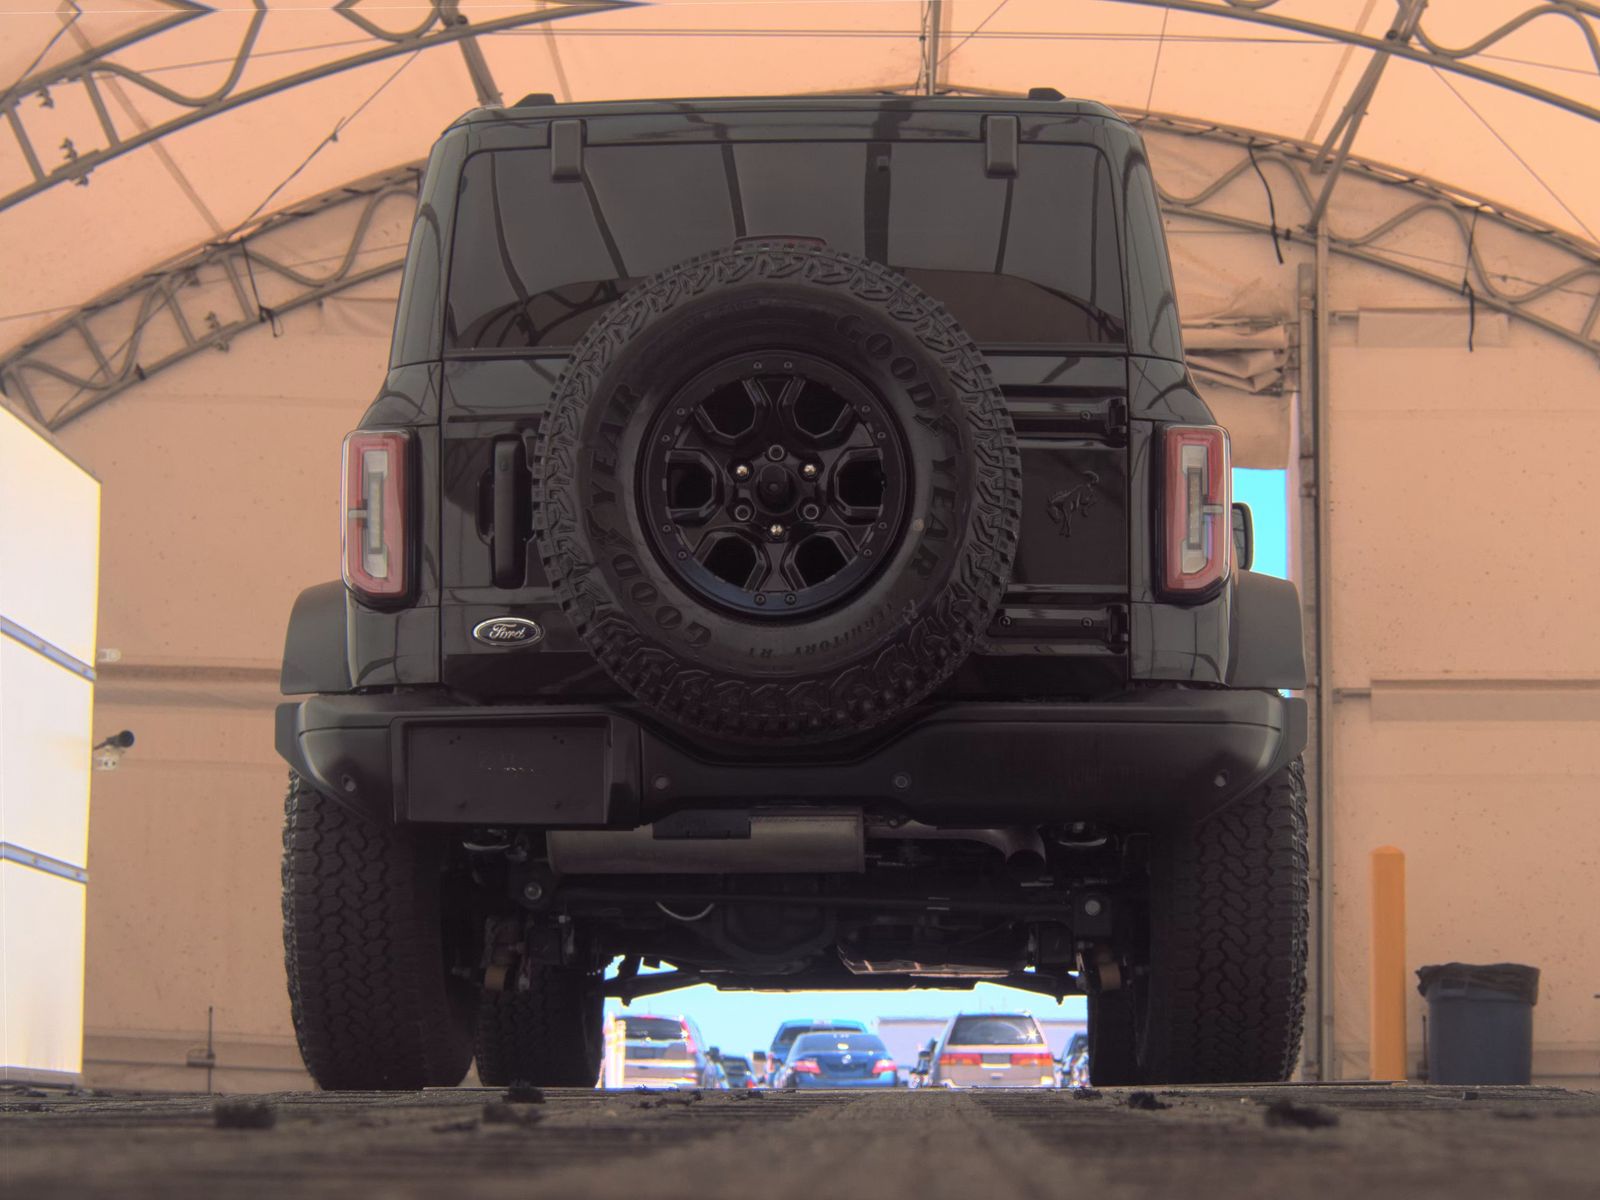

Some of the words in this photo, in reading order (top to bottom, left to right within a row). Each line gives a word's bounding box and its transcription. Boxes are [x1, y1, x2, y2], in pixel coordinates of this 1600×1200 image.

[585, 383, 713, 647] GOODYEAR
[835, 313, 960, 579] GOODYEAR
[488, 623, 527, 640] Ford
